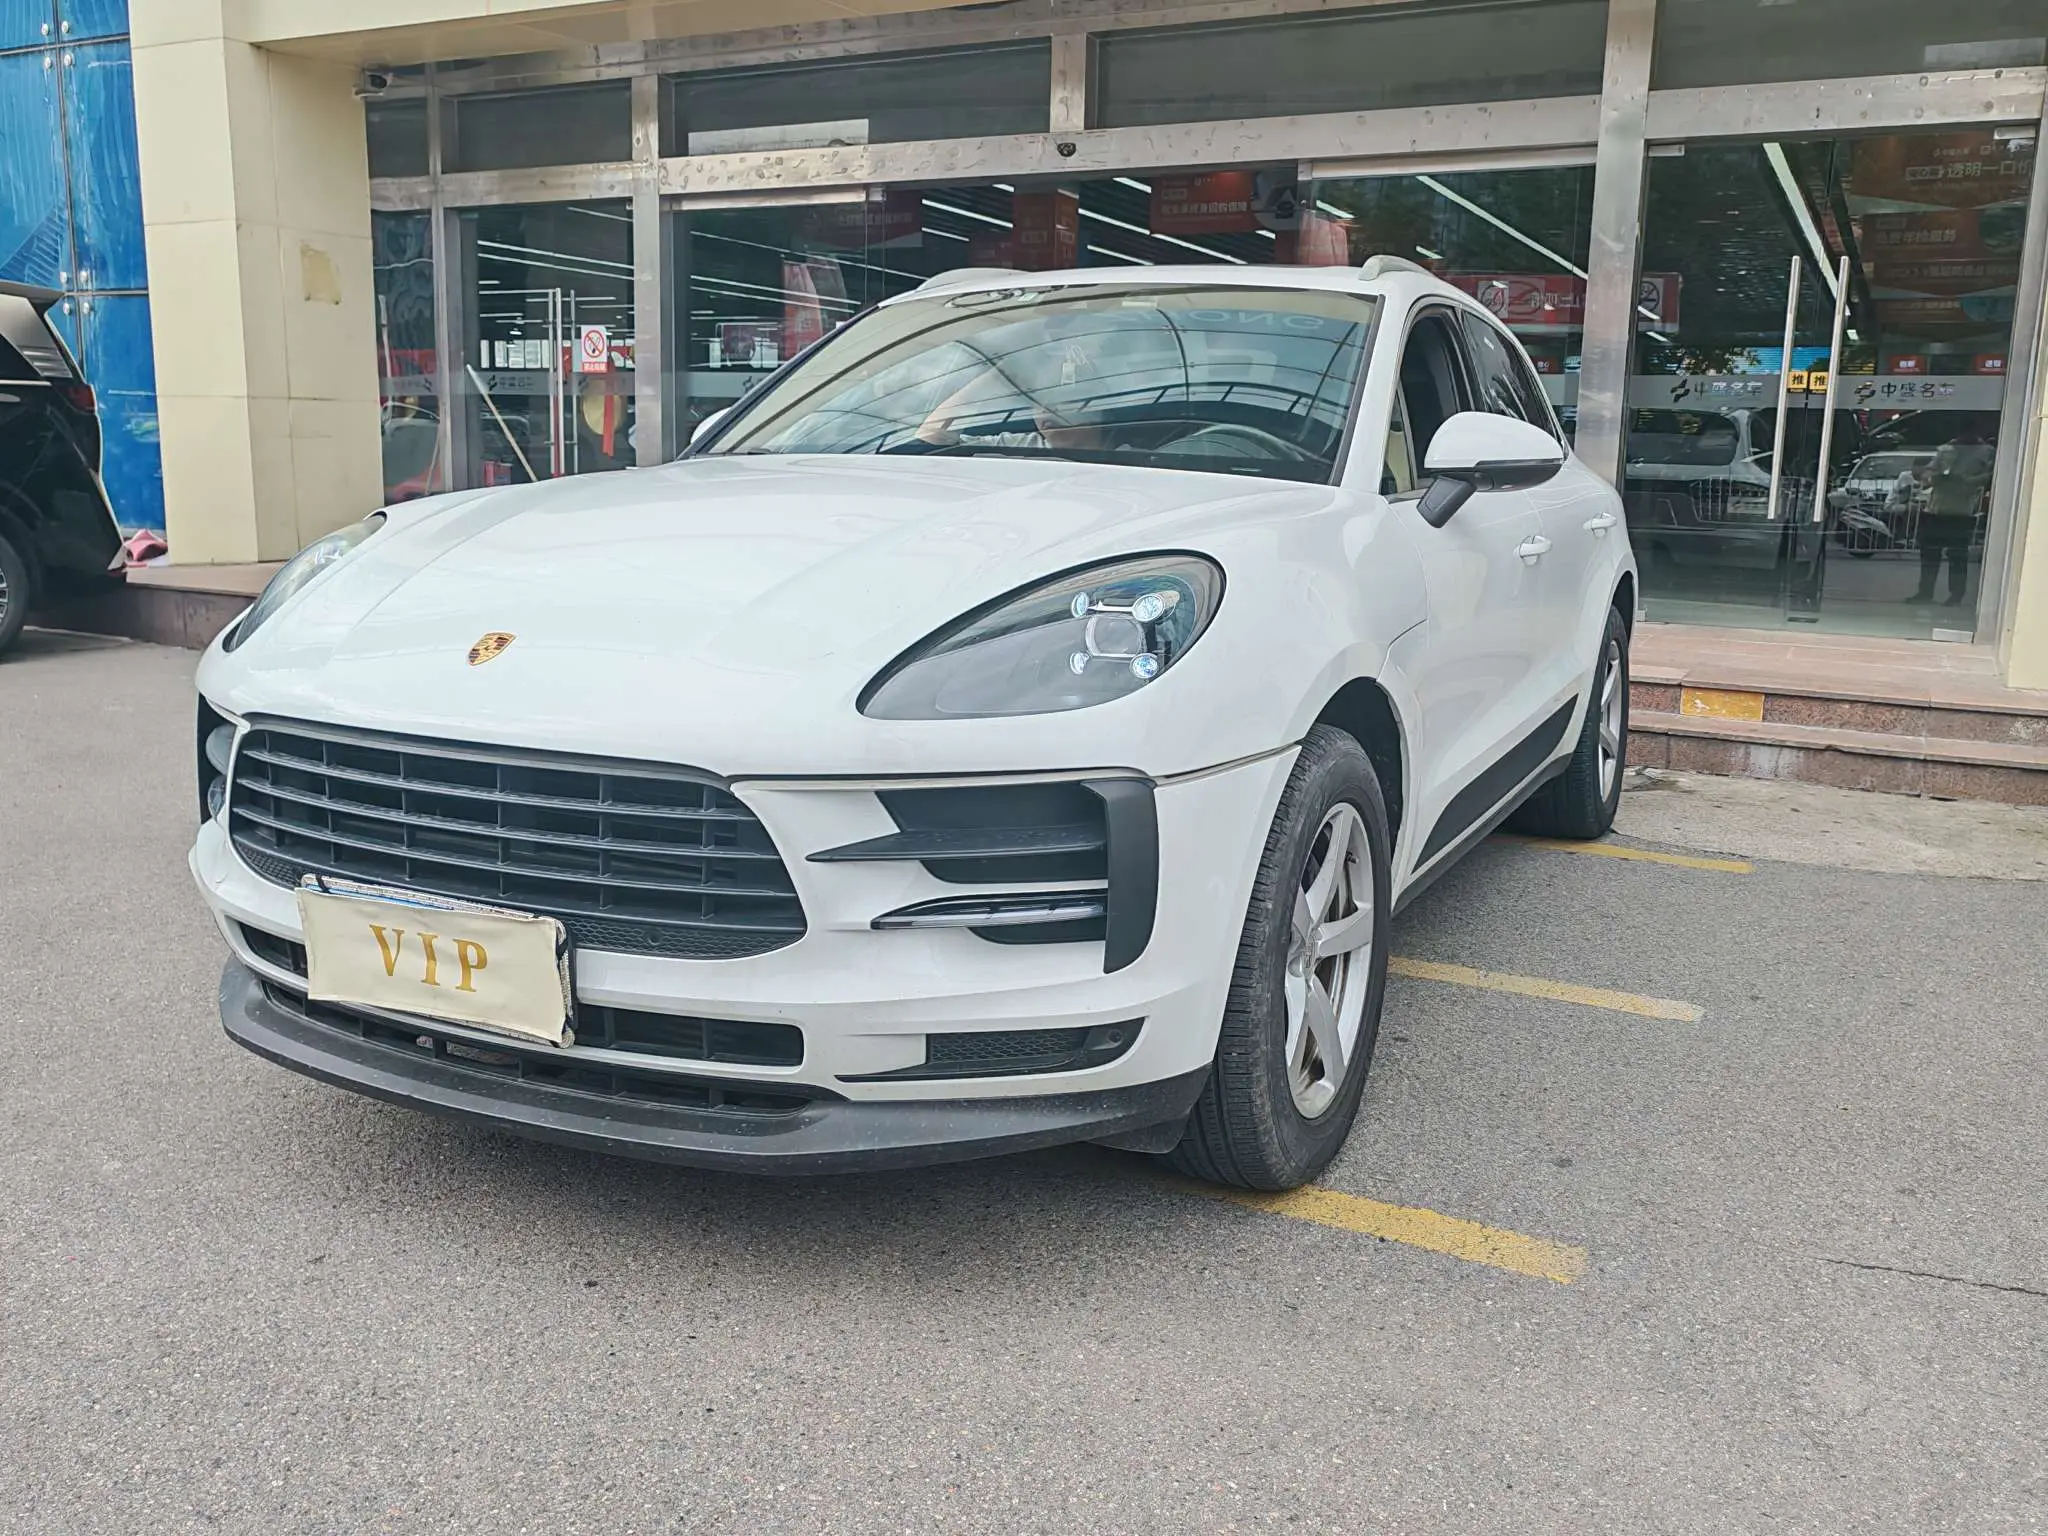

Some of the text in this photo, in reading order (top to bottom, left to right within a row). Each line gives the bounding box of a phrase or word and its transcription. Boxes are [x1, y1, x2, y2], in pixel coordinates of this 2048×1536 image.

[1881, 383, 1955, 397] 中盛名车
[369, 925, 488, 992] VIP
